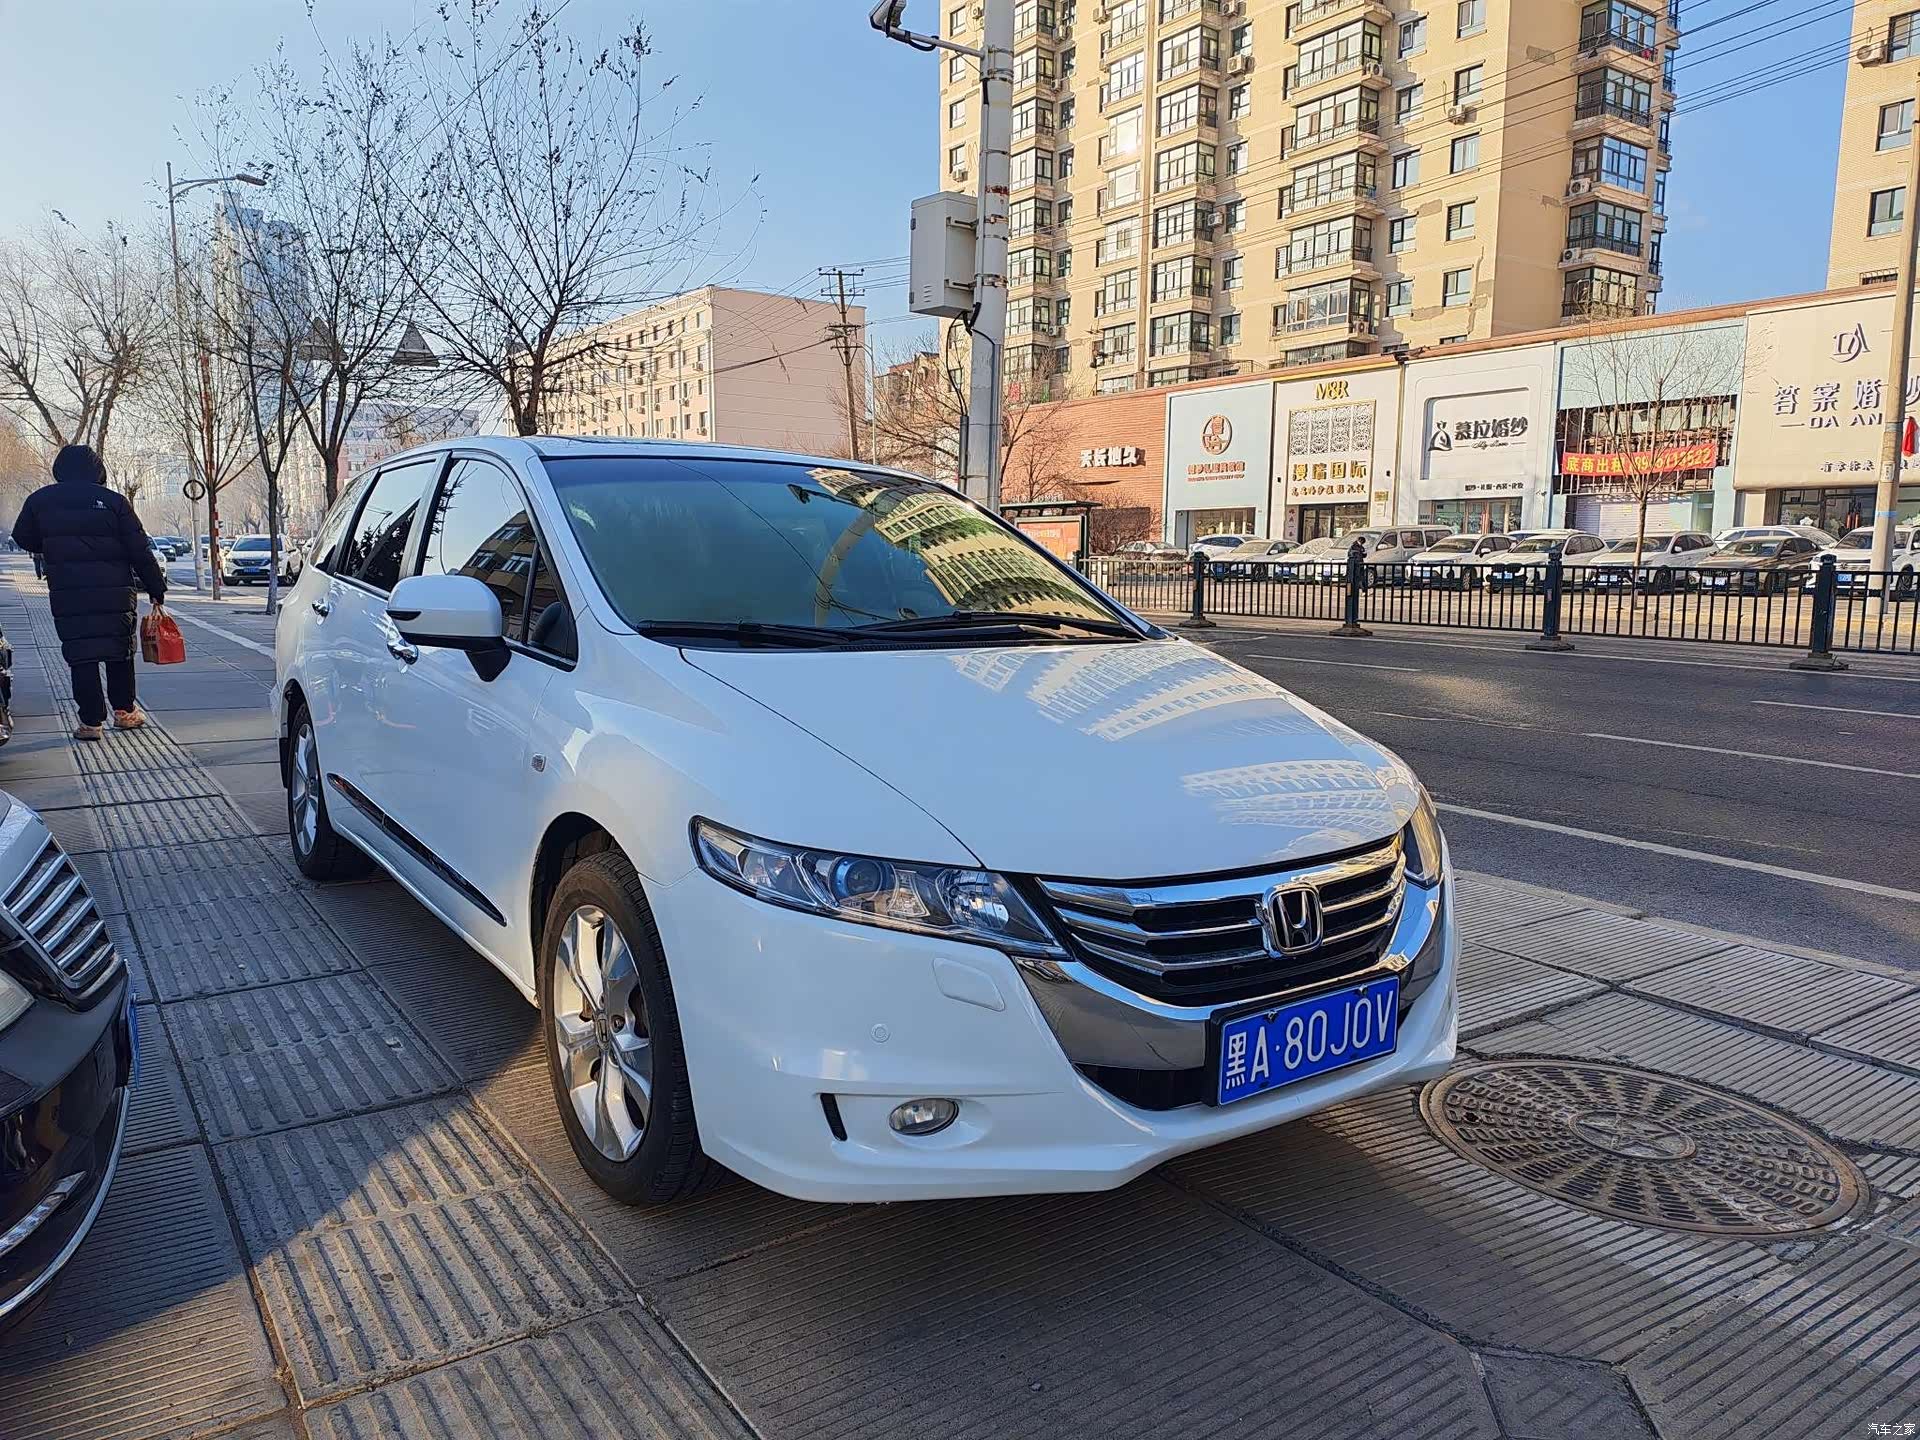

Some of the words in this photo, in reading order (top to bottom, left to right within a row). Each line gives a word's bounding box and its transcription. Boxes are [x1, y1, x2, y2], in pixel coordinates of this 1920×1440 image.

[1315, 380, 1350, 400] M&R
[1454, 416, 1529, 440] 慕拉婚纱
[1809, 415, 1840, 428] DA
[1849, 413, 1883, 426] AN
[1566, 456, 1625, 472] 底商出租
